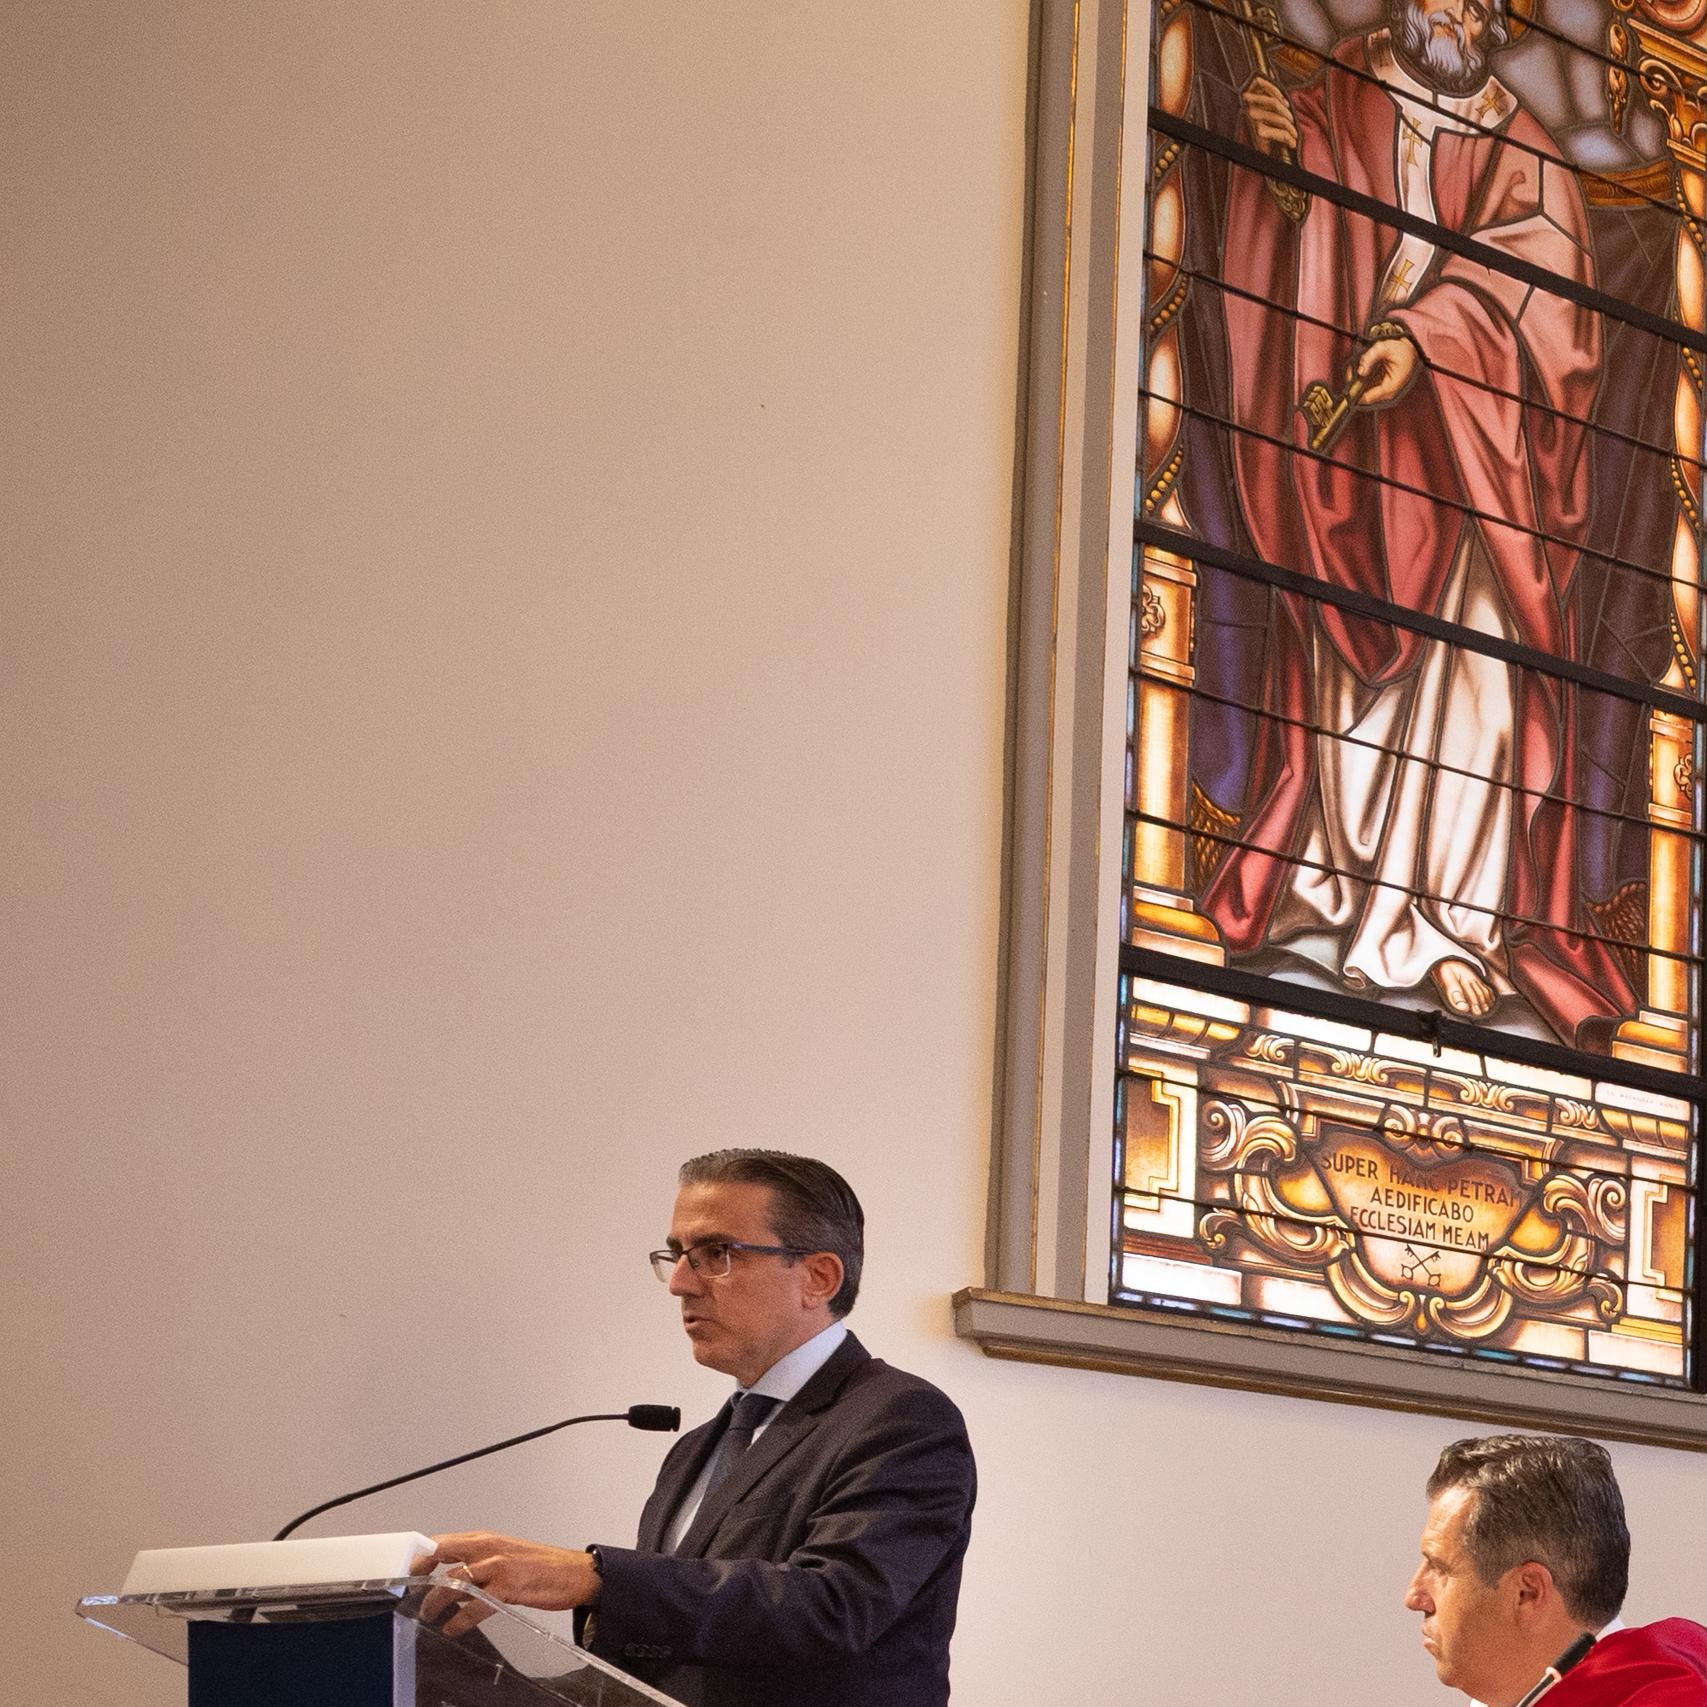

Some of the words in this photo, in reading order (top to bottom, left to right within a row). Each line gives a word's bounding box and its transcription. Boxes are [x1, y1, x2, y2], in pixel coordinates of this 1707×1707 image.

[1322, 1151, 1379, 1181] SUPER
[1370, 1186, 1474, 1224] AEDIFICABO
[1351, 1206, 1437, 1241] ECCLESIAM
[1442, 1223, 1490, 1250] MEAM
